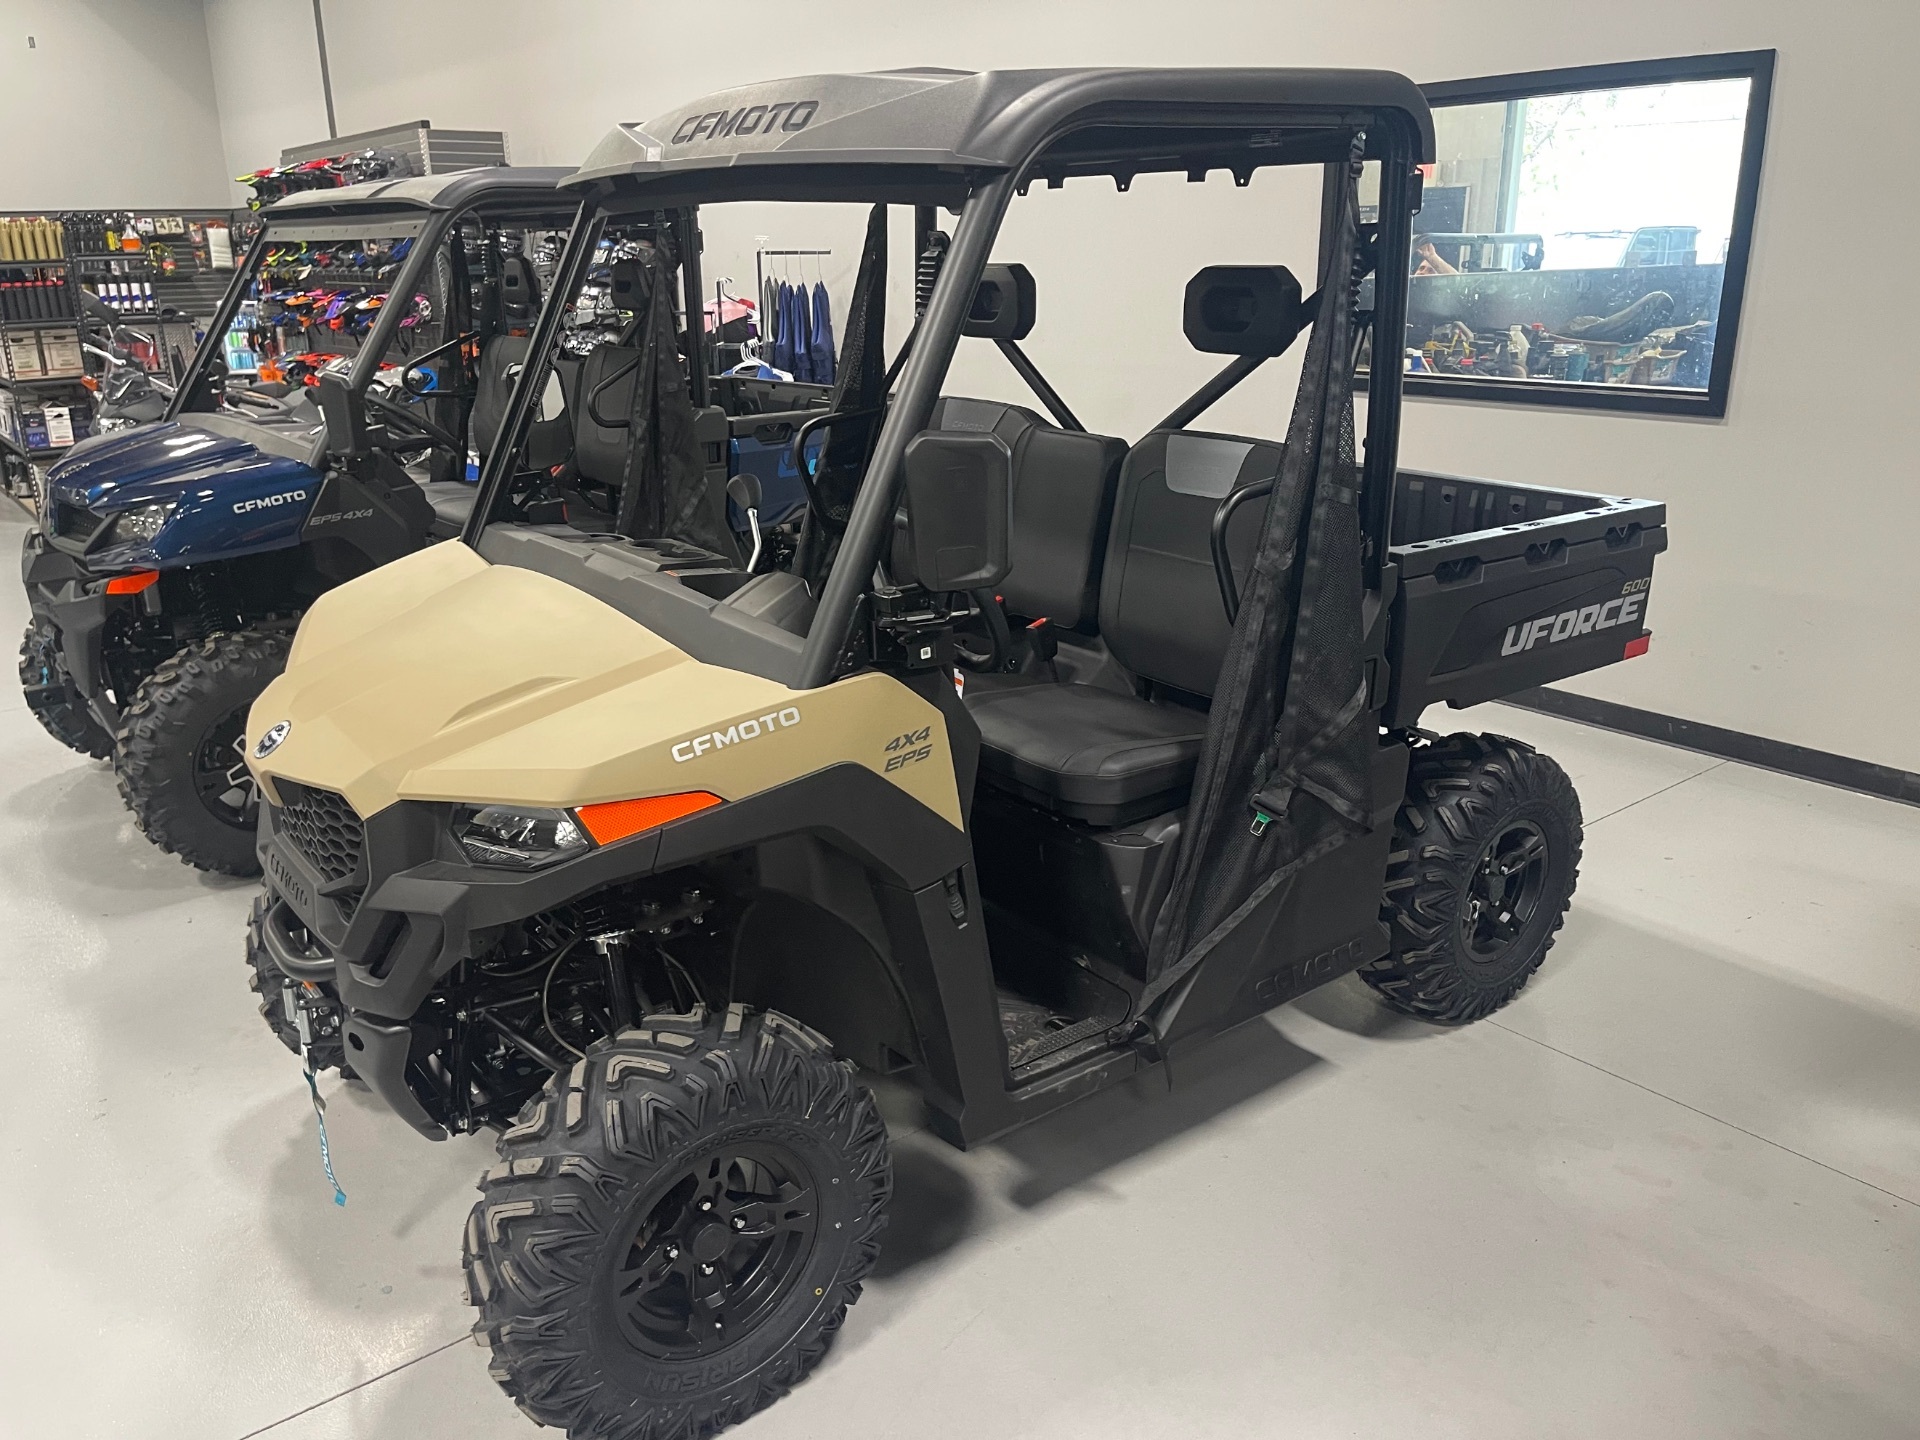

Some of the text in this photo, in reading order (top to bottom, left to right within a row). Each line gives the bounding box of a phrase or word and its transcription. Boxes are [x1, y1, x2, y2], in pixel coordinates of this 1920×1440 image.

[671, 100, 820, 146] CFMOTO
[233, 490, 307, 515] CFMOTO
[309, 508, 374, 526] EPS 4X4
[1621, 577, 1650, 595] 600
[1501, 592, 1645, 657] UFORCE
[671, 706, 801, 763] CFMOTO
[884, 725, 932, 753] 4X4
[884, 743, 933, 773] EPS
